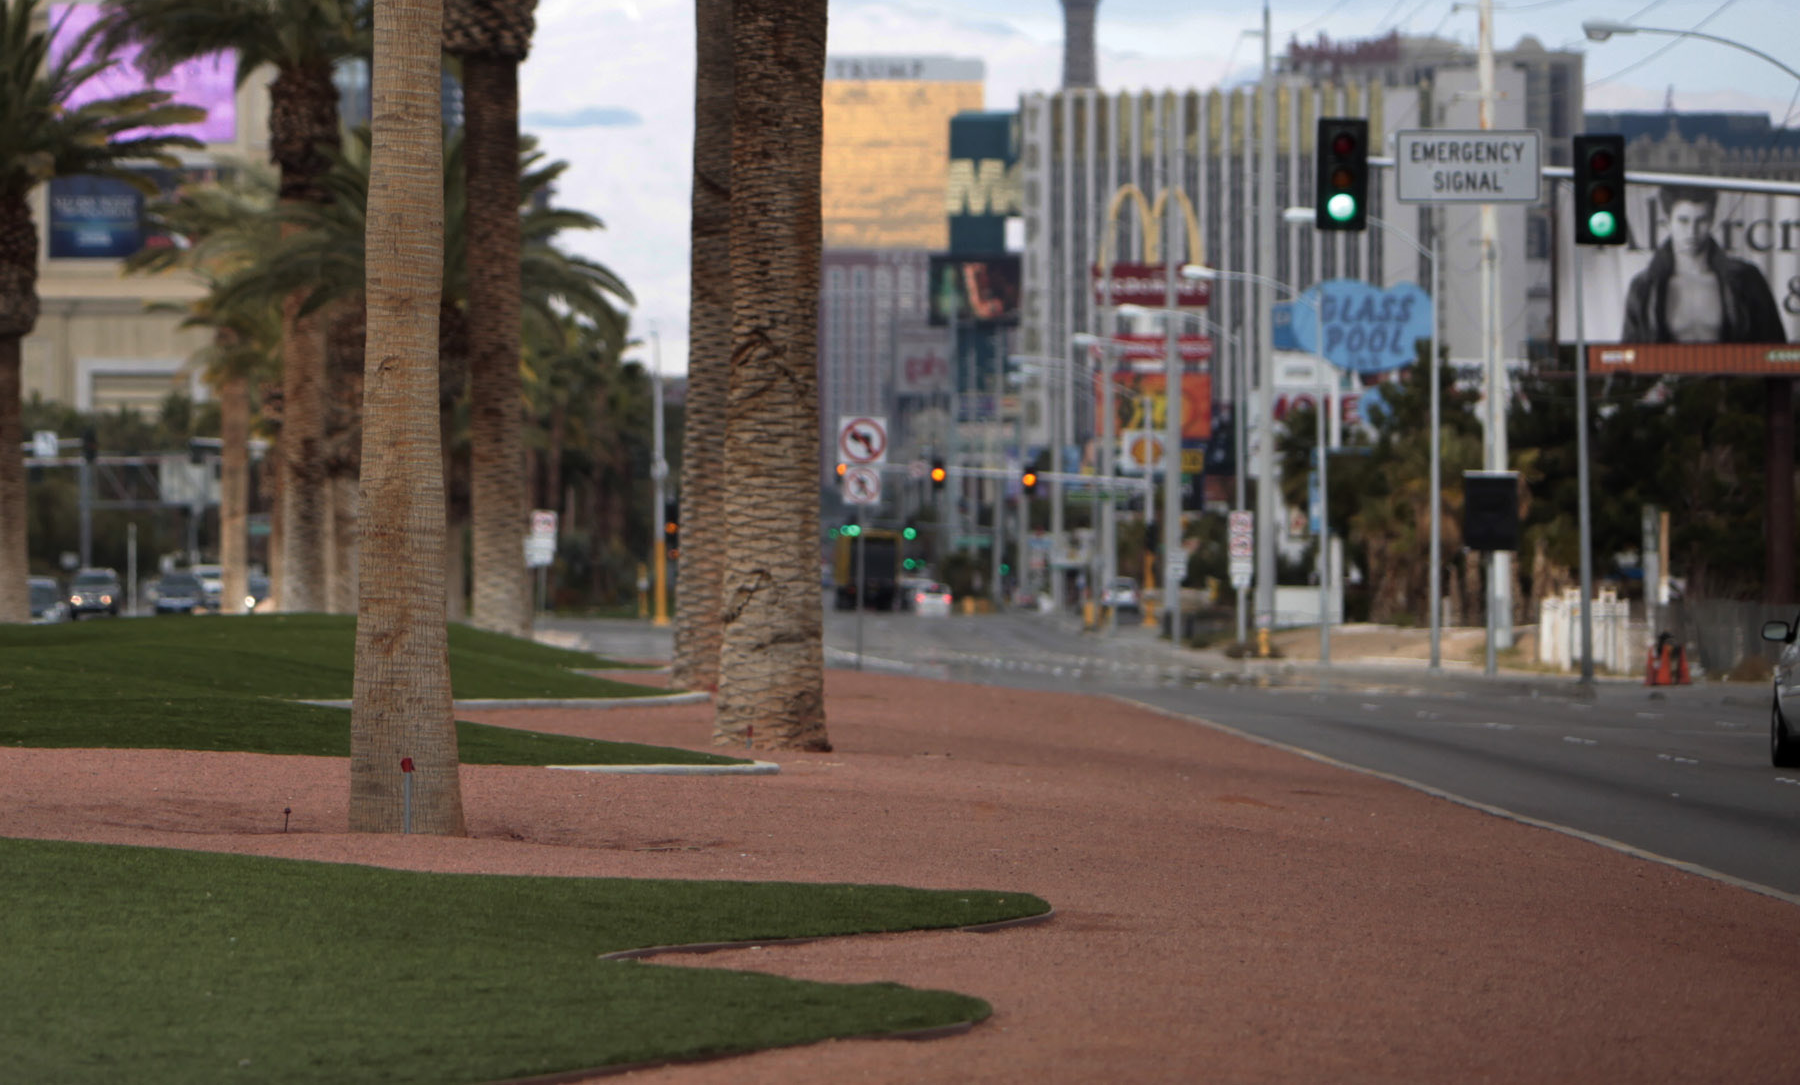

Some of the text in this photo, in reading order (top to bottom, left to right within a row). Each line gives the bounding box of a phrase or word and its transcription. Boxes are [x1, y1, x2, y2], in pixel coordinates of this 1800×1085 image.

[1410, 141, 1526, 165] EMERGENCY
[1433, 171, 1504, 193] SIGNAL
[1321, 293, 1416, 324] GLASS
[1326, 324, 1405, 355] POOL
